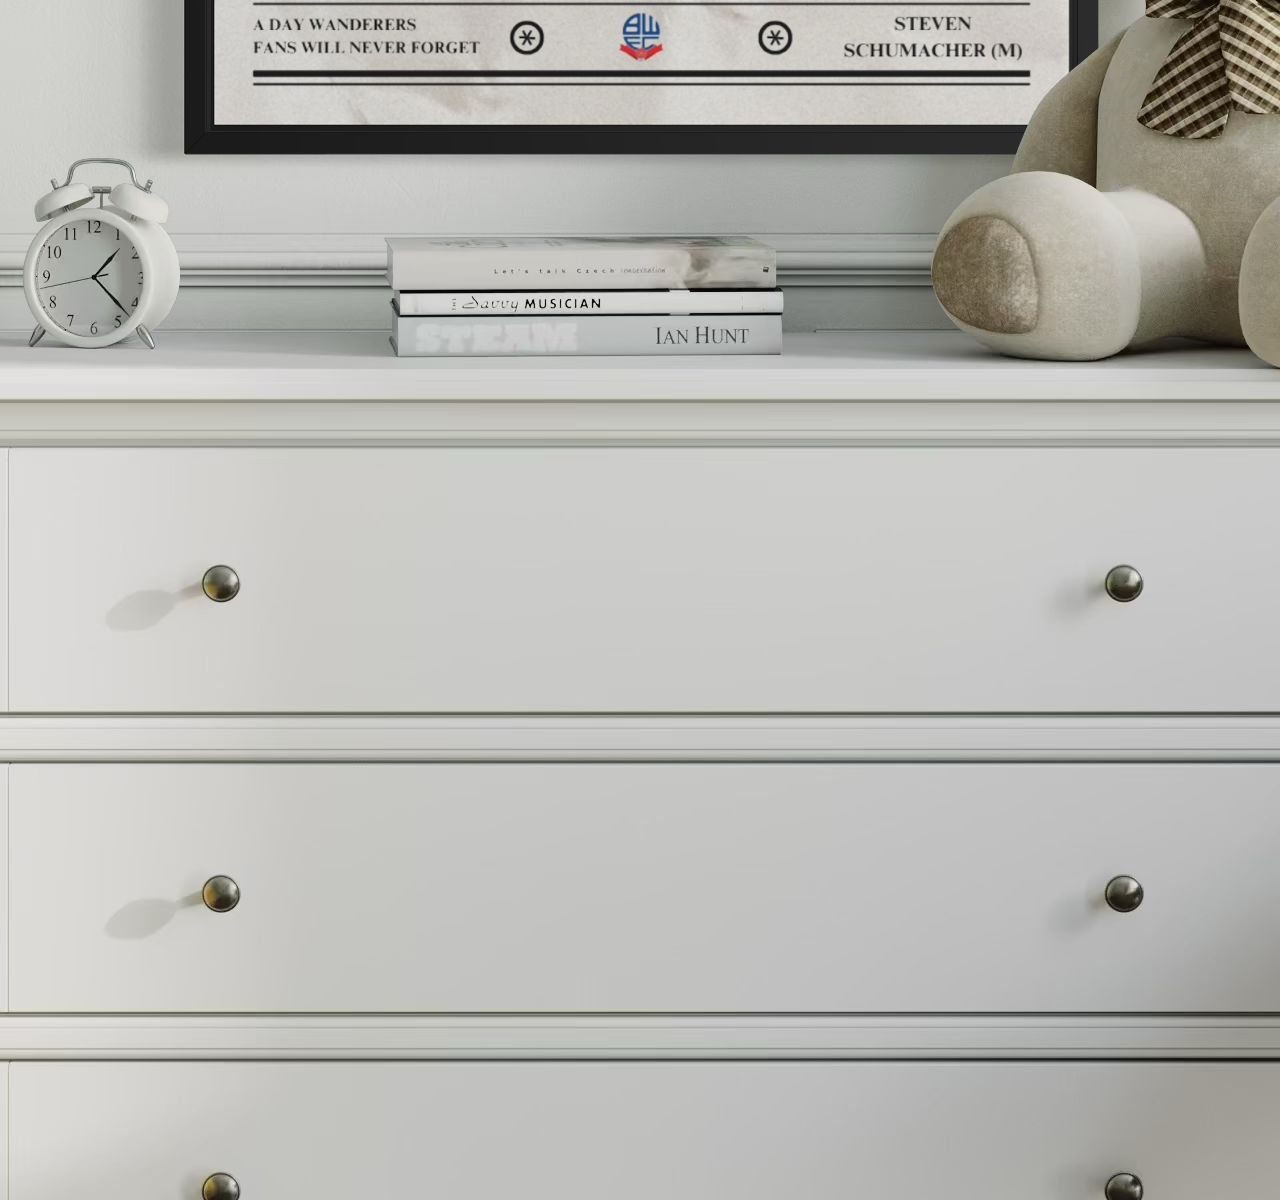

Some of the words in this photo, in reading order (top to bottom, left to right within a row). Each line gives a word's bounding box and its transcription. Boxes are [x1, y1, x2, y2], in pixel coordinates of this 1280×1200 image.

[254, 19, 264, 30] A
[270, 18, 304, 30] DAY
[309, 18, 416, 31] WANDERERS
[894, 16, 971, 31] STEVEN
[254, 41, 297, 54] FANS
[301, 41, 345, 53] WILL
[350, 41, 406, 53] NEVER
[412, 41, 480, 54] FORGET
[844, 43, 985, 57] SCHUMACHER
[991, 43, 1022, 60] (M)
[87, 220, 101, 234] 12
[64, 228, 77, 240] 11
[116, 228, 121, 240] 1
[47, 246, 62, 259] 10
[131, 246, 139, 259] 2
[42, 270, 51, 283] 9
[49, 295, 57, 308] 8
[462, 296, 519, 312] Savvy
[524, 298, 601, 309] MUSICIAN
[66, 314, 74, 327] 7
[114, 315, 122, 329] 5
[90, 321, 98, 335] 6
[416, 323, 578, 352] STEAM
